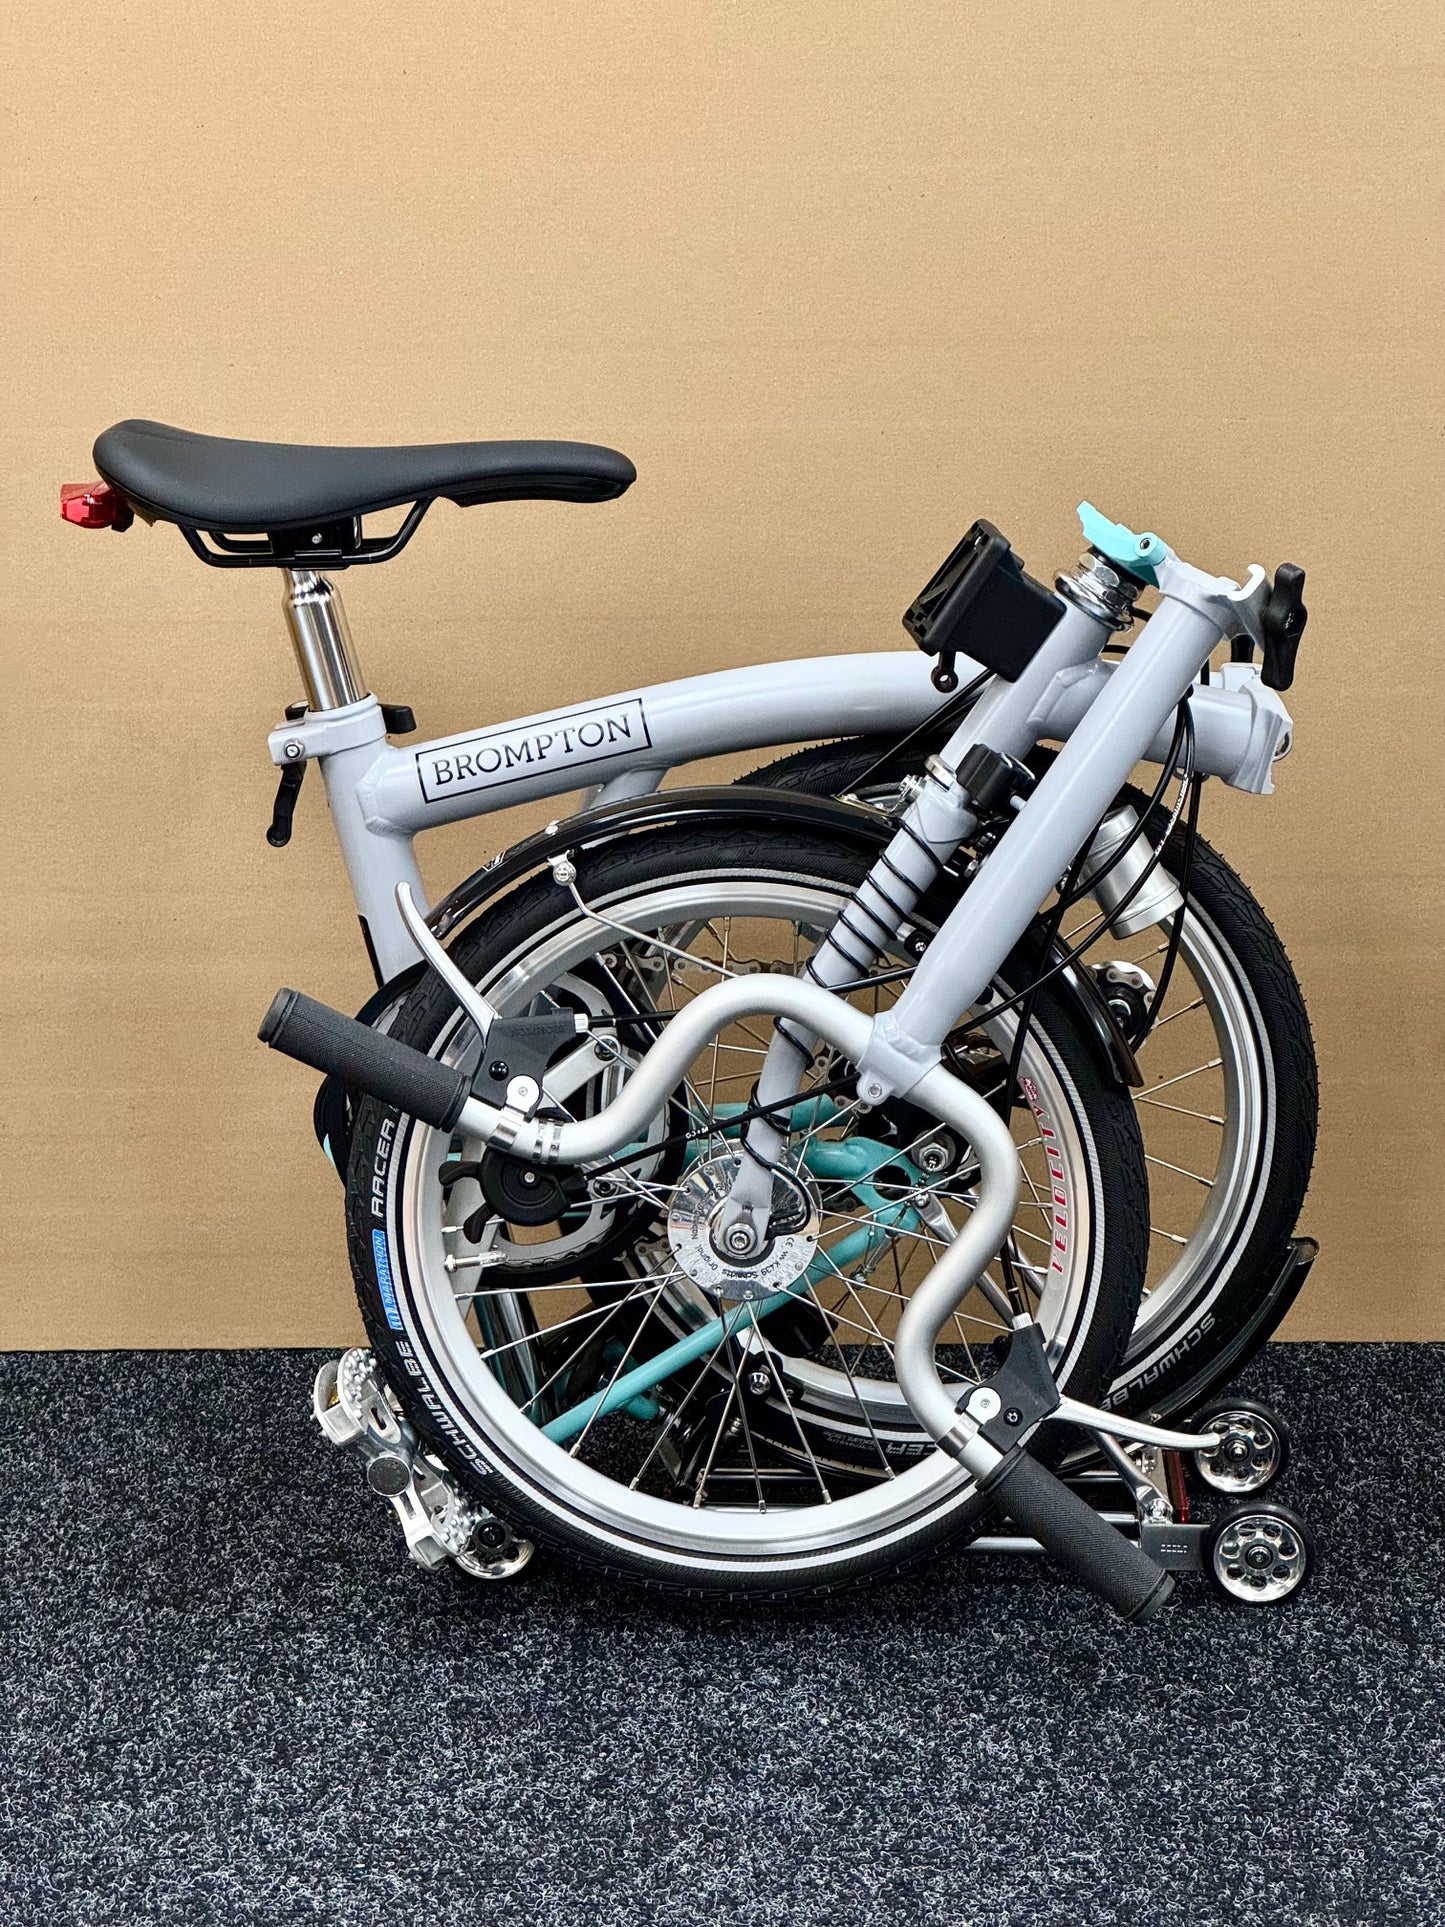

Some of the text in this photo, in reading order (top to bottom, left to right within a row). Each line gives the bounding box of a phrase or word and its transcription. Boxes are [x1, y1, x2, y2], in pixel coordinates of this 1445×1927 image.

[432, 713, 632, 786] BROMPTON
[371, 1117, 395, 1219] RACER
[1031, 1104, 1069, 1274] VELOCITY
[696, 1243, 718, 1271] Original
[721, 1268, 759, 1280] Schmidts
[761, 1261, 781, 1277] K439
[1100, 1312, 1216, 1411] SCHWALBE
[395, 1340, 494, 1475] SCHWALBE
